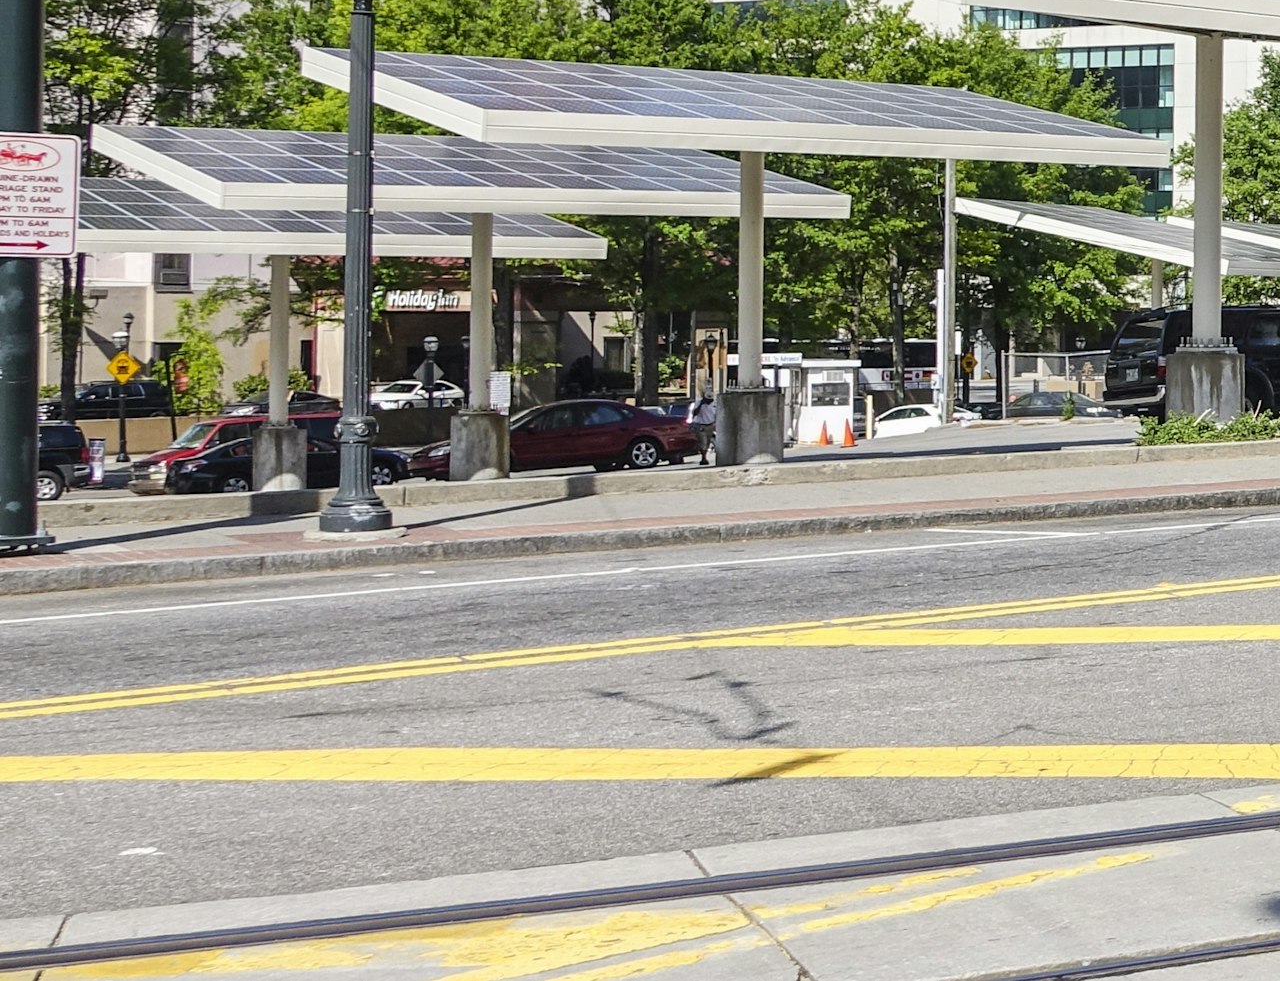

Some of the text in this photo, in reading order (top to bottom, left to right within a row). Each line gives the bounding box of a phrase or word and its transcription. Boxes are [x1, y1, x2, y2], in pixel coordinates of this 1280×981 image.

[32, 185, 63, 193] STAND
[17, 205, 29, 213] TO
[33, 206, 66, 214] FRIDAY
[33, 230, 70, 238] HOLIDAYS
[390, 288, 459, 311] Holiday Inn
